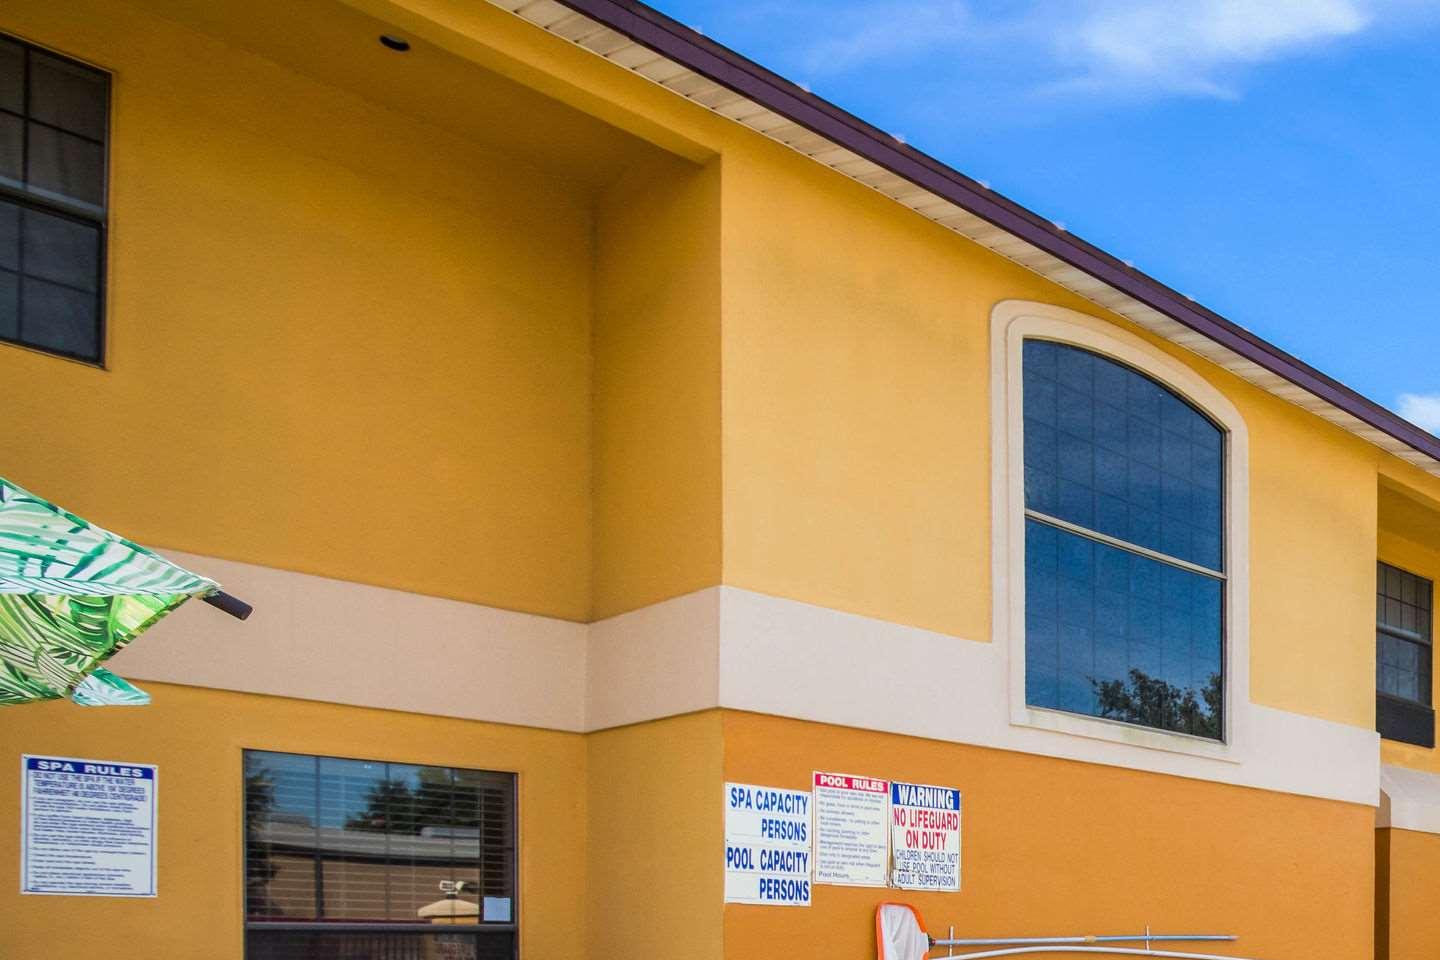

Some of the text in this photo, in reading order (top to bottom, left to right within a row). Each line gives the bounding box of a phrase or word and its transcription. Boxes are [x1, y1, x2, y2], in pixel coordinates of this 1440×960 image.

[37, 760, 143, 777] SPA RULES
[820, 775, 884, 791] POOL RULES
[730, 787, 752, 809] SPA
[756, 790, 808, 815] CAPACITY
[898, 784, 954, 810] WARNING
[761, 818, 807, 842] PERSONS
[894, 808, 906, 827] NO
[910, 809, 958, 831] LIFEGUARD
[906, 830, 919, 848] ON
[922, 831, 947, 850] DUTY
[727, 847, 755, 870] POOL
[760, 849, 808, 873] CAPACITY
[896, 849, 959, 864] CHILDREN SHOULD NOT
[912, 862, 928, 873] POOL
[930, 863, 955, 875] WITHOUT
[760, 878, 809, 902] PERSONS
[898, 873, 956, 887] ADULT SUPERVISION
